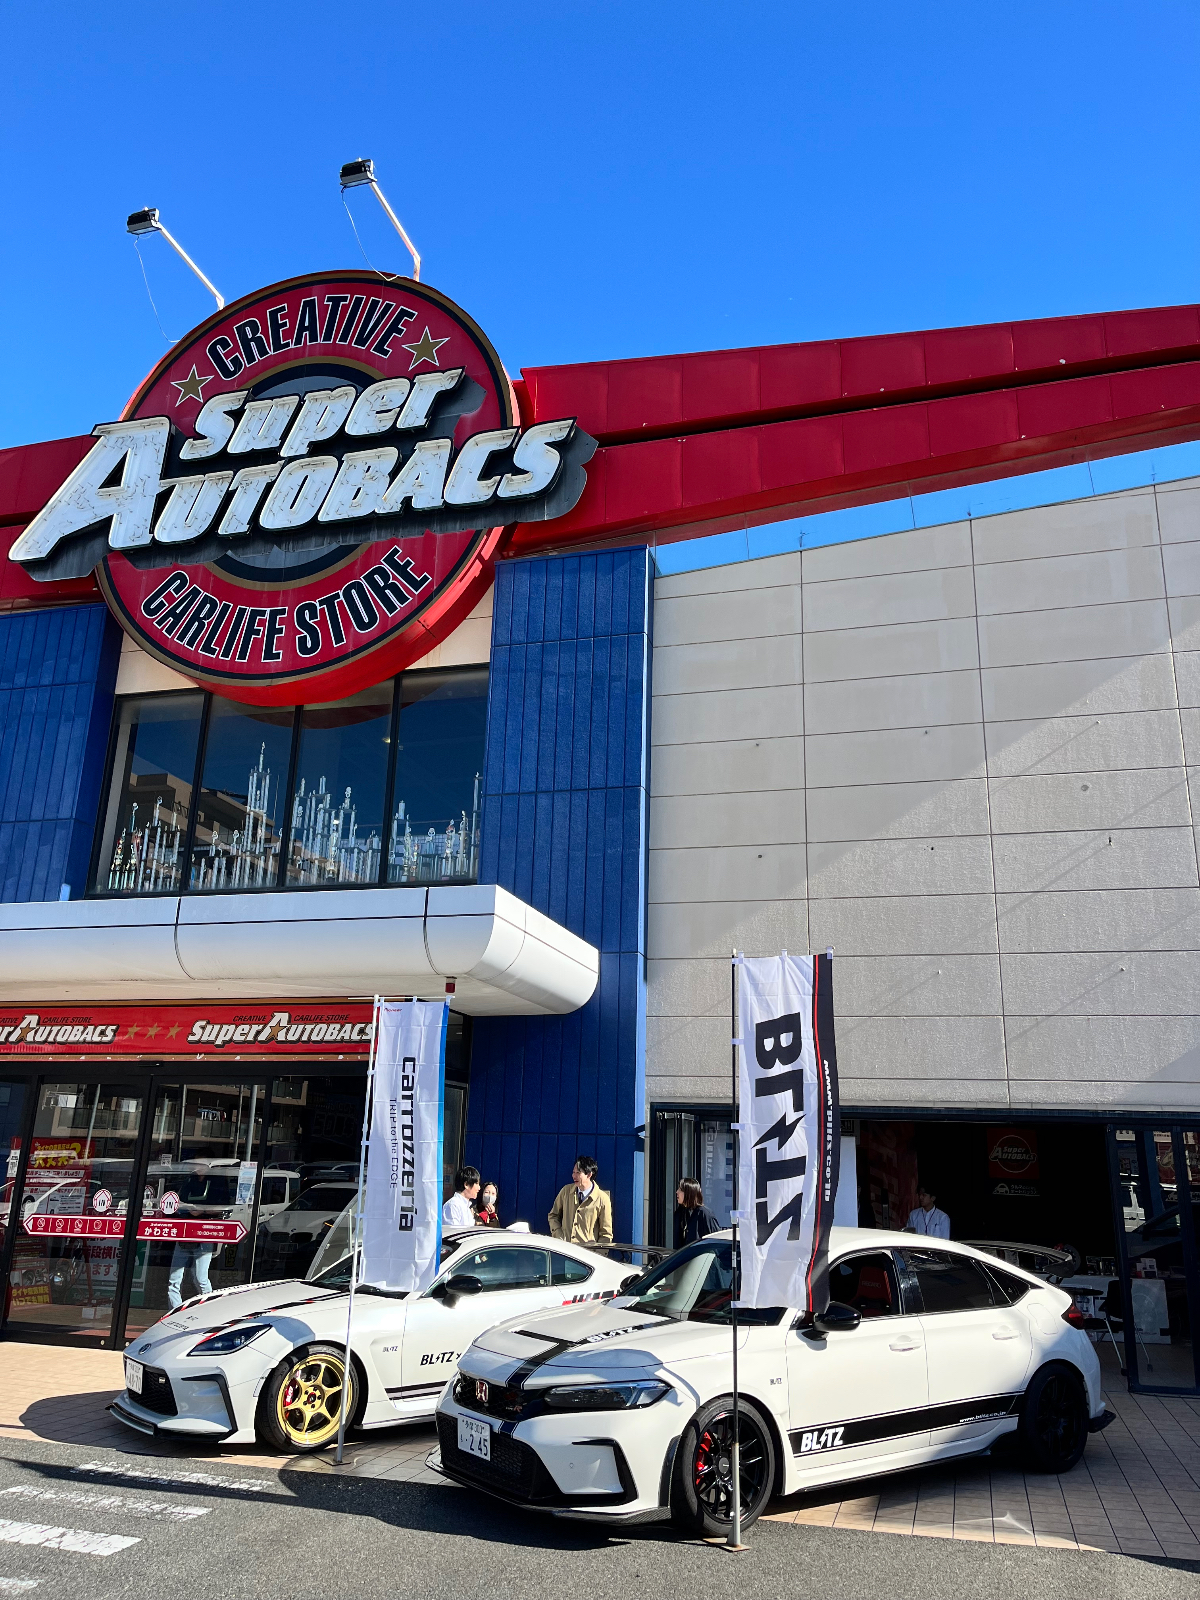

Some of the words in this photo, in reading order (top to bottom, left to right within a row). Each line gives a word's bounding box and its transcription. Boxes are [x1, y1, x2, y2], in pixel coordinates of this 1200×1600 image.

[207, 294, 417, 381] CREATIVE
[180, 366, 466, 461] Super
[8, 415, 578, 562] AUTOBACS
[141, 569, 287, 663] CARLIFE
[295, 545, 432, 658] STORE
[233, 1014, 267, 1022] CREATIVE
[294, 1014, 325, 1022] CARLIFE
[326, 1013, 350, 1021] STORE
[187, 1019, 263, 1047] Super
[390, 1127, 397, 1135] to
[399, 1056, 417, 1232] carrozzeria
[390, 1157, 399, 1188] EDGE
[165, 1201, 173, 1209] IN
[144, 1226, 178, 1236] かわさき
[420, 1351, 454, 1366] BLITZ
[801, 1426, 844, 1452] BLITZ
